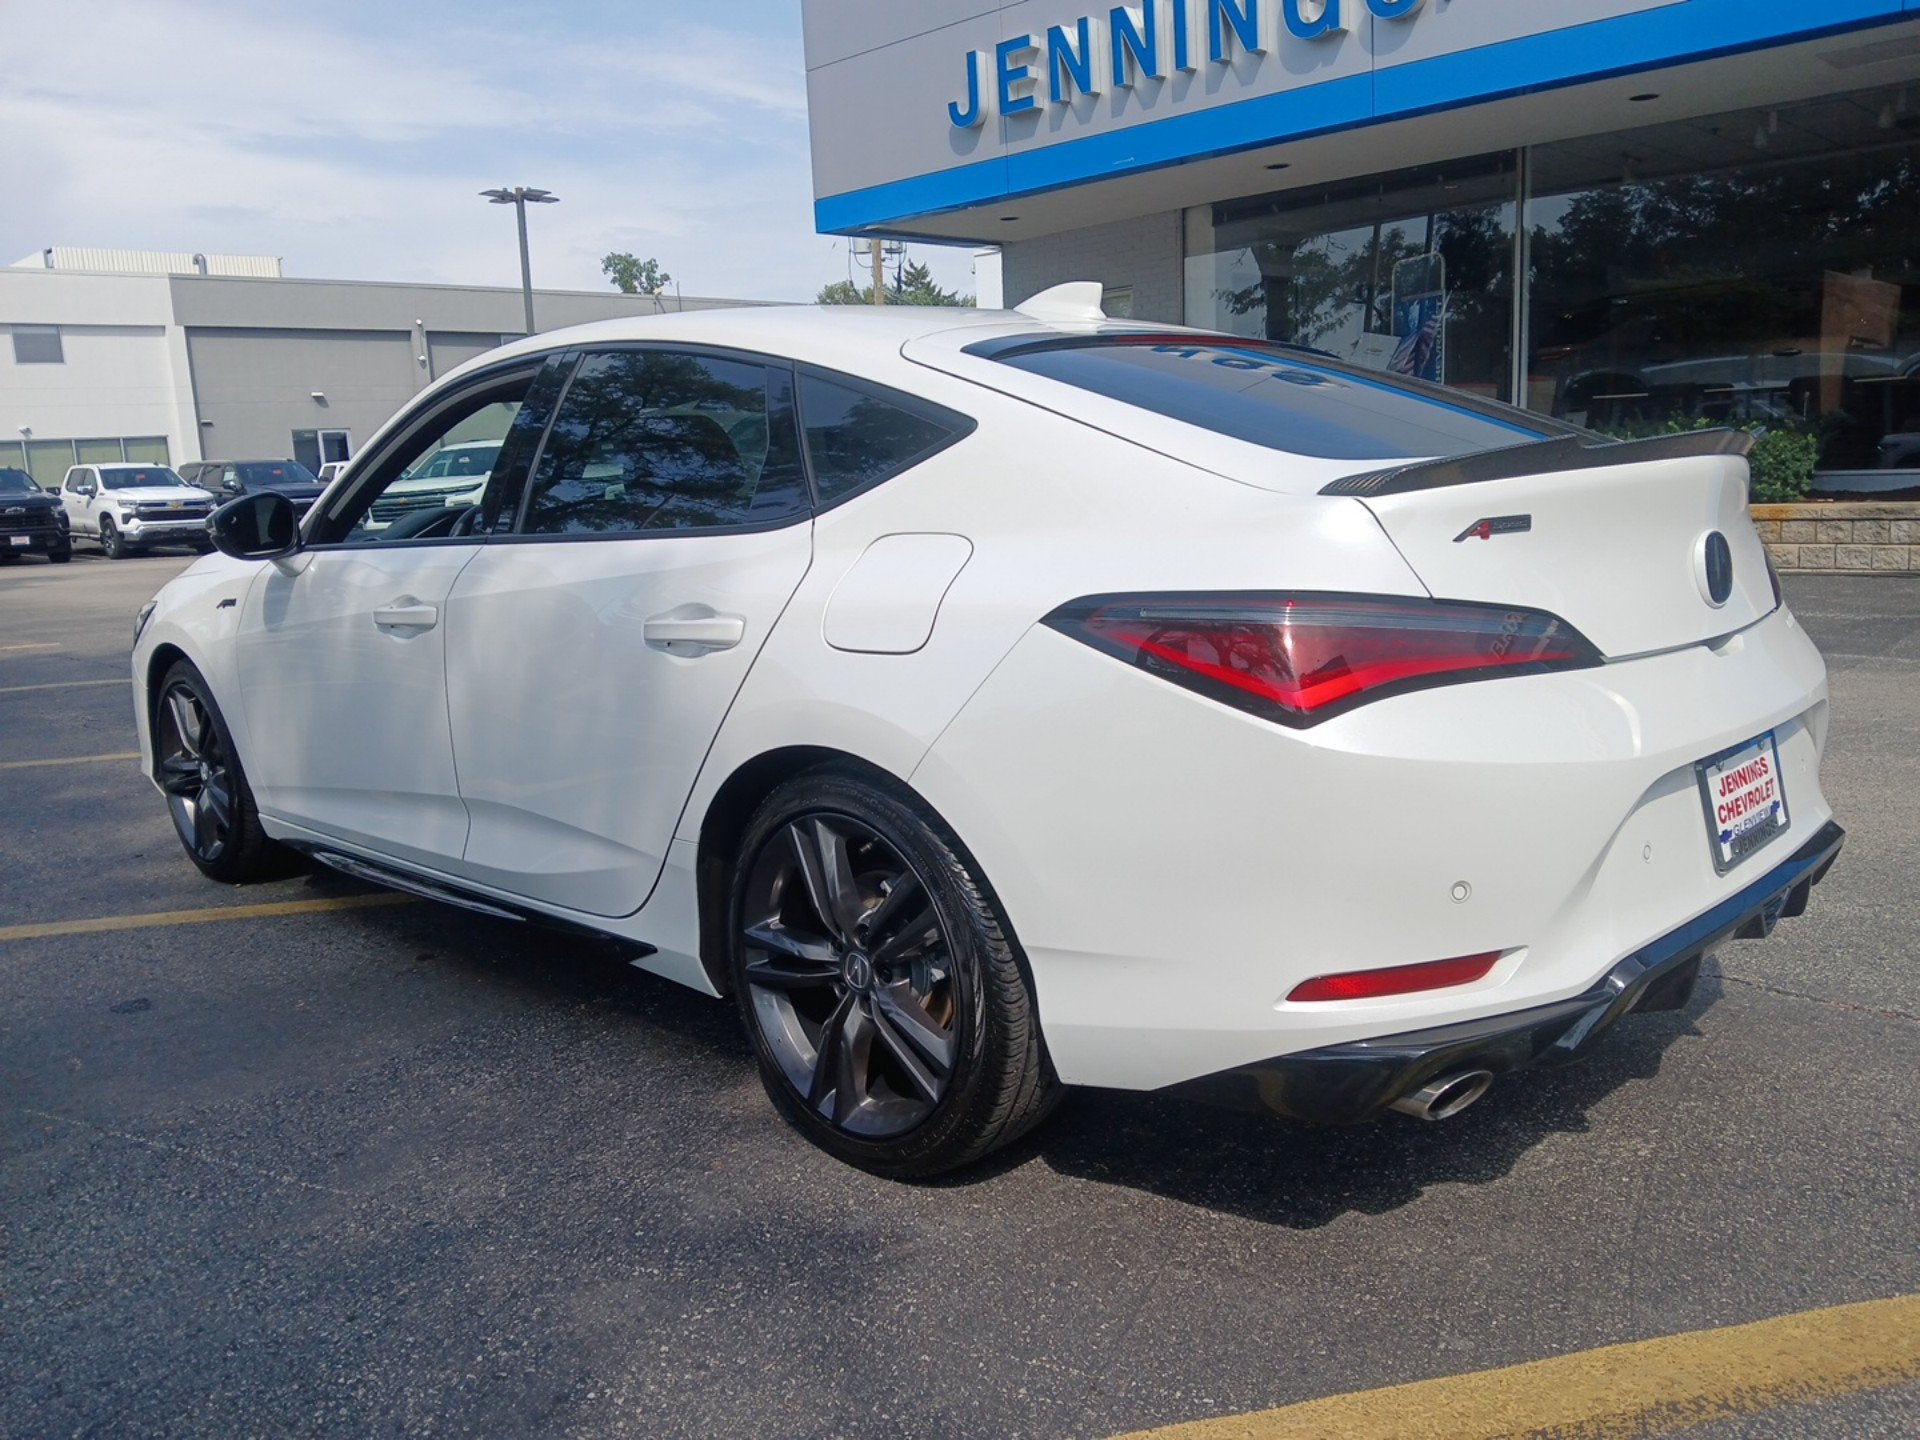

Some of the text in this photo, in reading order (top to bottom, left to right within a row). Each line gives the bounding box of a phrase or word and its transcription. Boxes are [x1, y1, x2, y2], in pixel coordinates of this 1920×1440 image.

[948, 0, 1421, 128] JENNIN
[1719, 756, 1769, 797] JENNINGS
[1718, 778, 1776, 824] CHEVROLET
